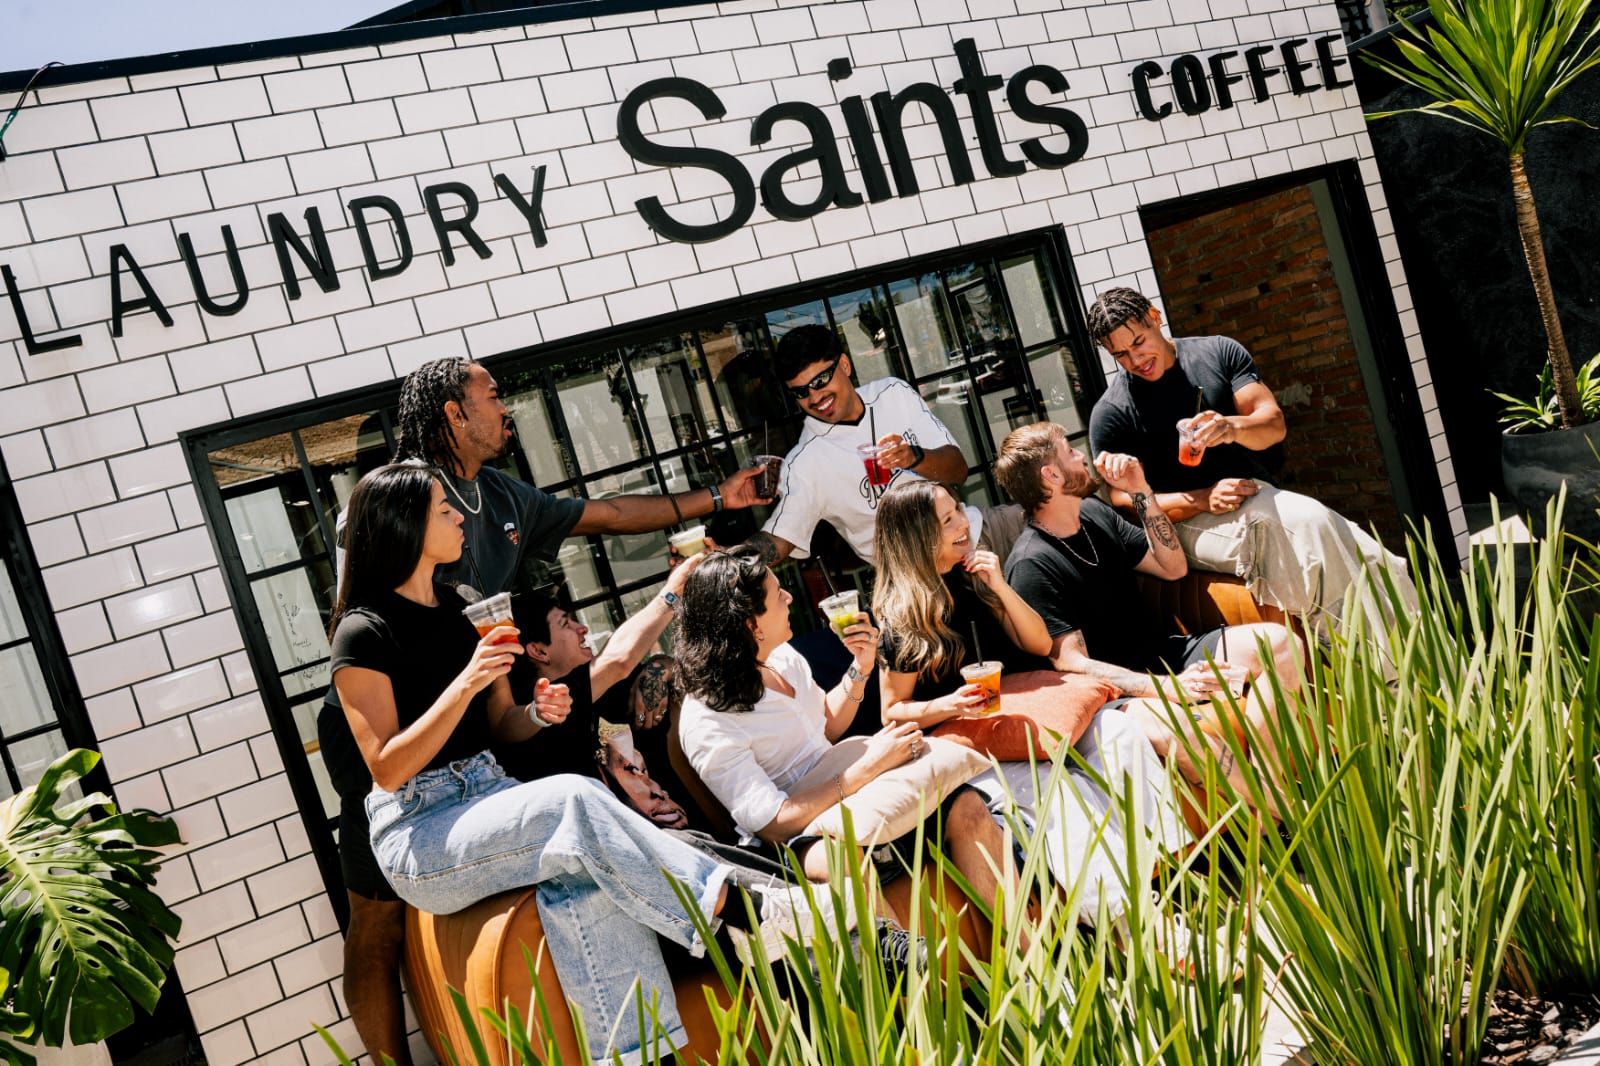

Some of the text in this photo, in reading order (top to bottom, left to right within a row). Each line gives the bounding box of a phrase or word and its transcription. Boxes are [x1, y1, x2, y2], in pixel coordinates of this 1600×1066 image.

[1, 33, 1354, 356] LAUNDRY Saints COFFEE
